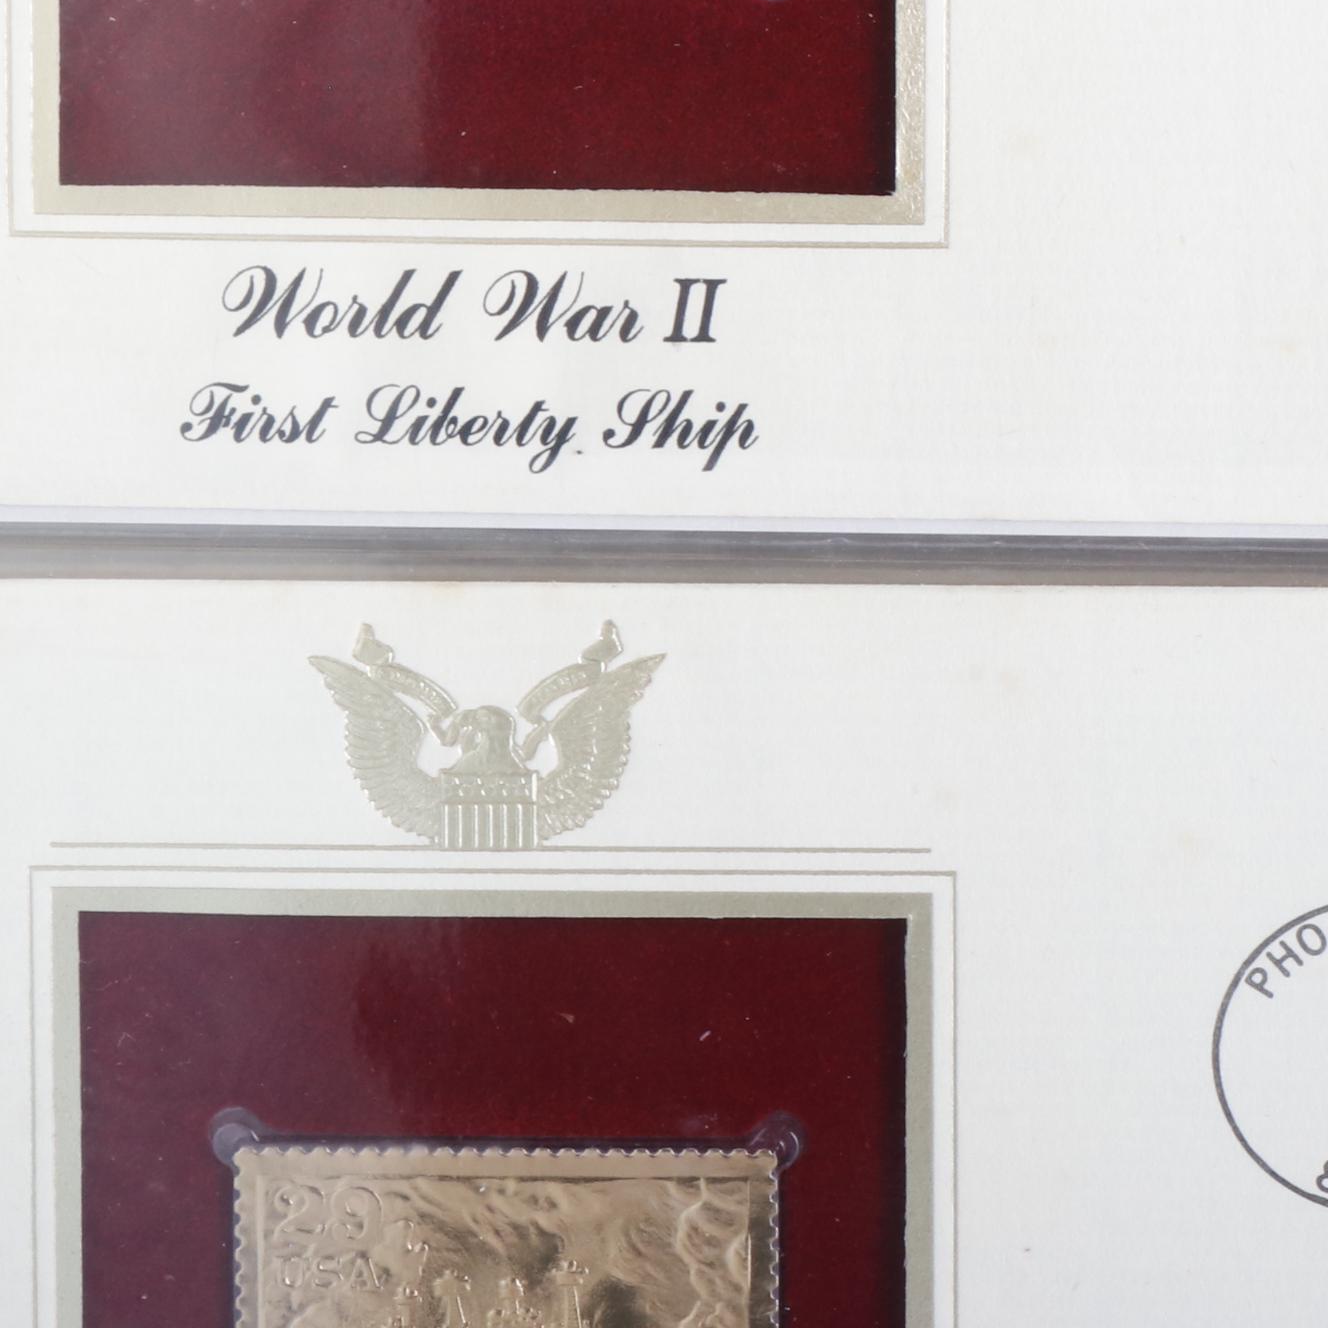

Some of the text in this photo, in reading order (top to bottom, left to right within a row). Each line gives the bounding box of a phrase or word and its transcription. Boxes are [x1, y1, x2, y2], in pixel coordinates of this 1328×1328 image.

[222, 265, 727, 343] World War II
[180, 382, 759, 474] First Liberty Ship
[272, 1184, 384, 1241] 29
[274, 1251, 384, 1291] USA
